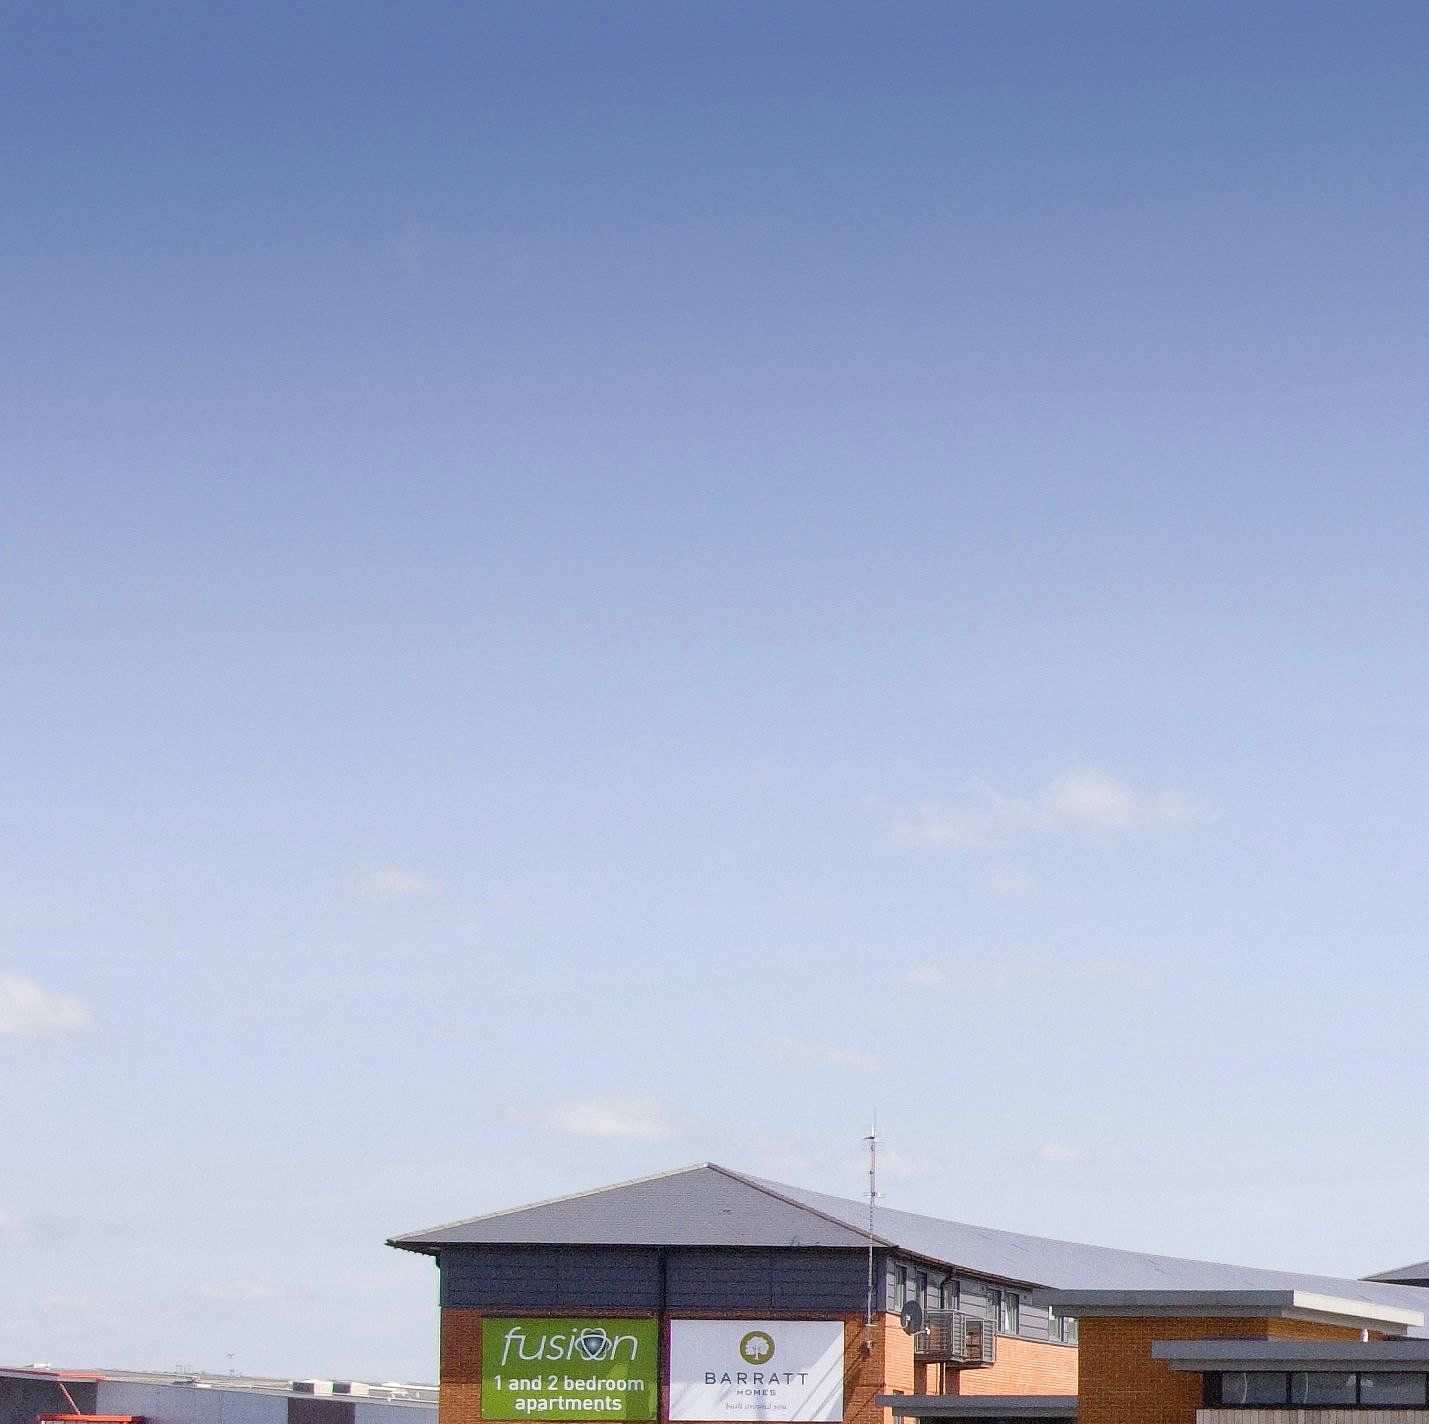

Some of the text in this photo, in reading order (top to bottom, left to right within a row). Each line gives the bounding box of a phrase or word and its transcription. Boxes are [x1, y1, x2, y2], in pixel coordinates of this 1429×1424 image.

[494, 1374, 645, 1391] 1 and 2 bedroom
[704, 1372, 809, 1386] BARRATT
[736, 1389, 777, 1397] HOMES
[514, 1395, 622, 1415] apartments
